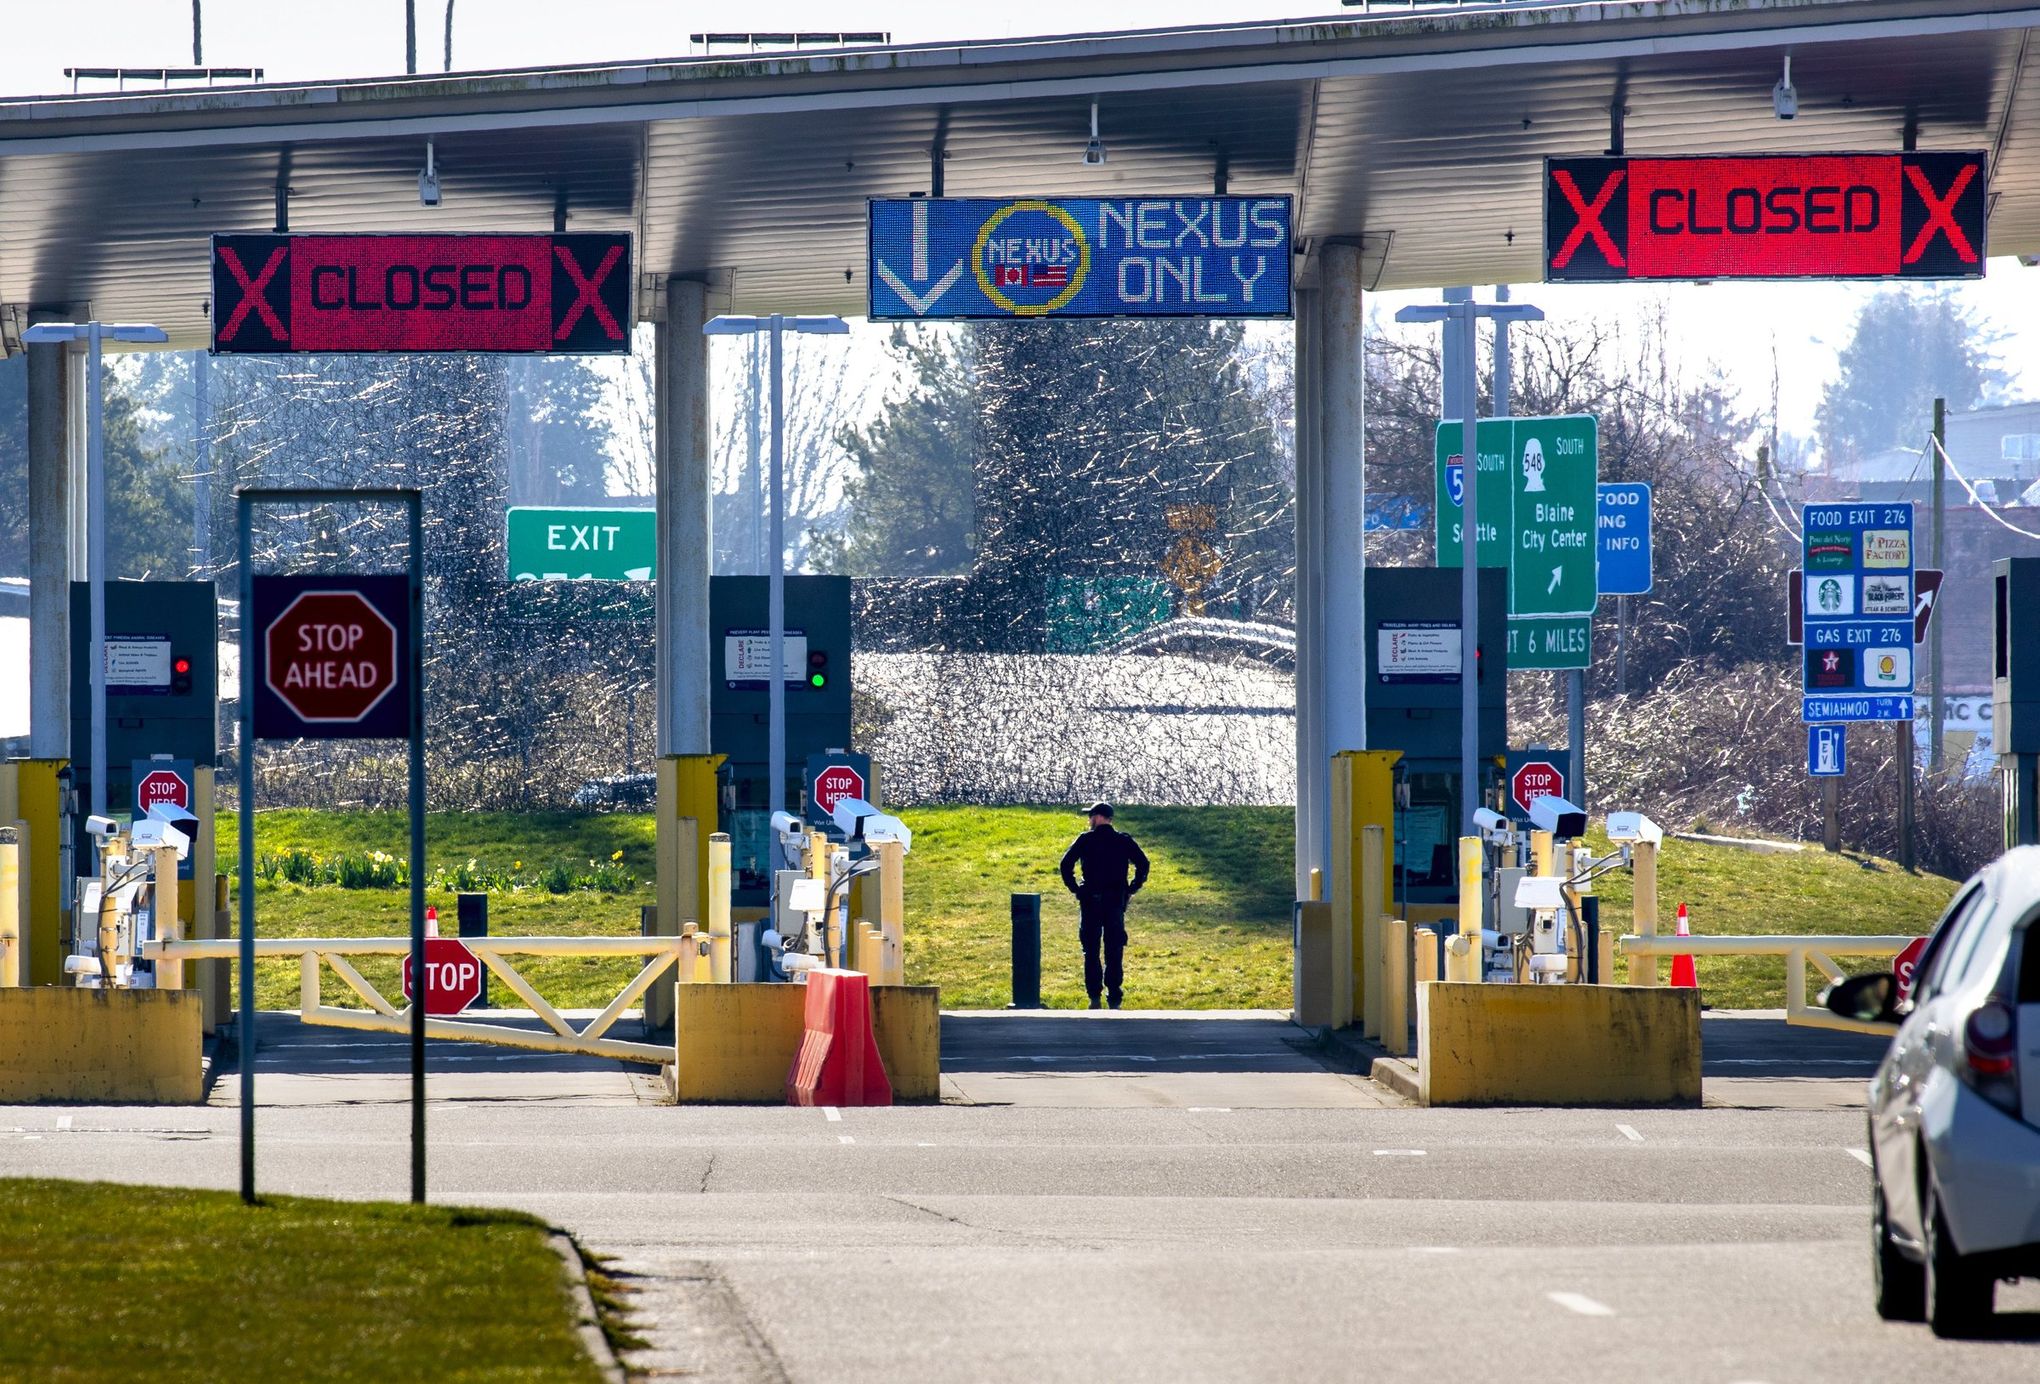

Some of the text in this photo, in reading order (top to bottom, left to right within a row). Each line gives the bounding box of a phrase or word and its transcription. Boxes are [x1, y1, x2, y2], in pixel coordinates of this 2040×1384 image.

[1650, 185, 1880, 235] CLOSED
[1101, 200, 1286, 248] NEXUS
[988, 238, 1077, 263] NEXUS
[311, 264, 532, 310] CLOSED
[1118, 255, 1267, 302] ONLY
[1557, 437, 1584, 455] SOUTH
[1477, 453, 1504, 471] SOUTH
[1524, 453, 1542, 472] 548
[1535, 503, 1575, 522] Blaine
[1810, 509, 1906, 526] FOOD EXIT 276
[548, 525, 620, 550] EXIT
[1453, 523, 1497, 543] Sttle
[1522, 528, 1587, 552] City Center
[1878, 537, 1906, 548] PIZZA
[1607, 537, 1639, 550] INFO
[1866, 549, 1906, 560] FACTORY
[298, 624, 363, 651] STOP
[1529, 630, 1536, 653] 6
[1546, 628, 1585, 653] MILES
[1816, 628, 1901, 643] GAS EXIT 276
[284, 661, 377, 688] AHEAD
[1808, 701, 1869, 718] SEMIAHMOO
[1877, 710, 1882, 718] 2
[149, 782, 177, 794] STOP
[826, 778, 852, 789] STOP
[1525, 774, 1552, 786] STOP
[409, 963, 475, 991] TOP
